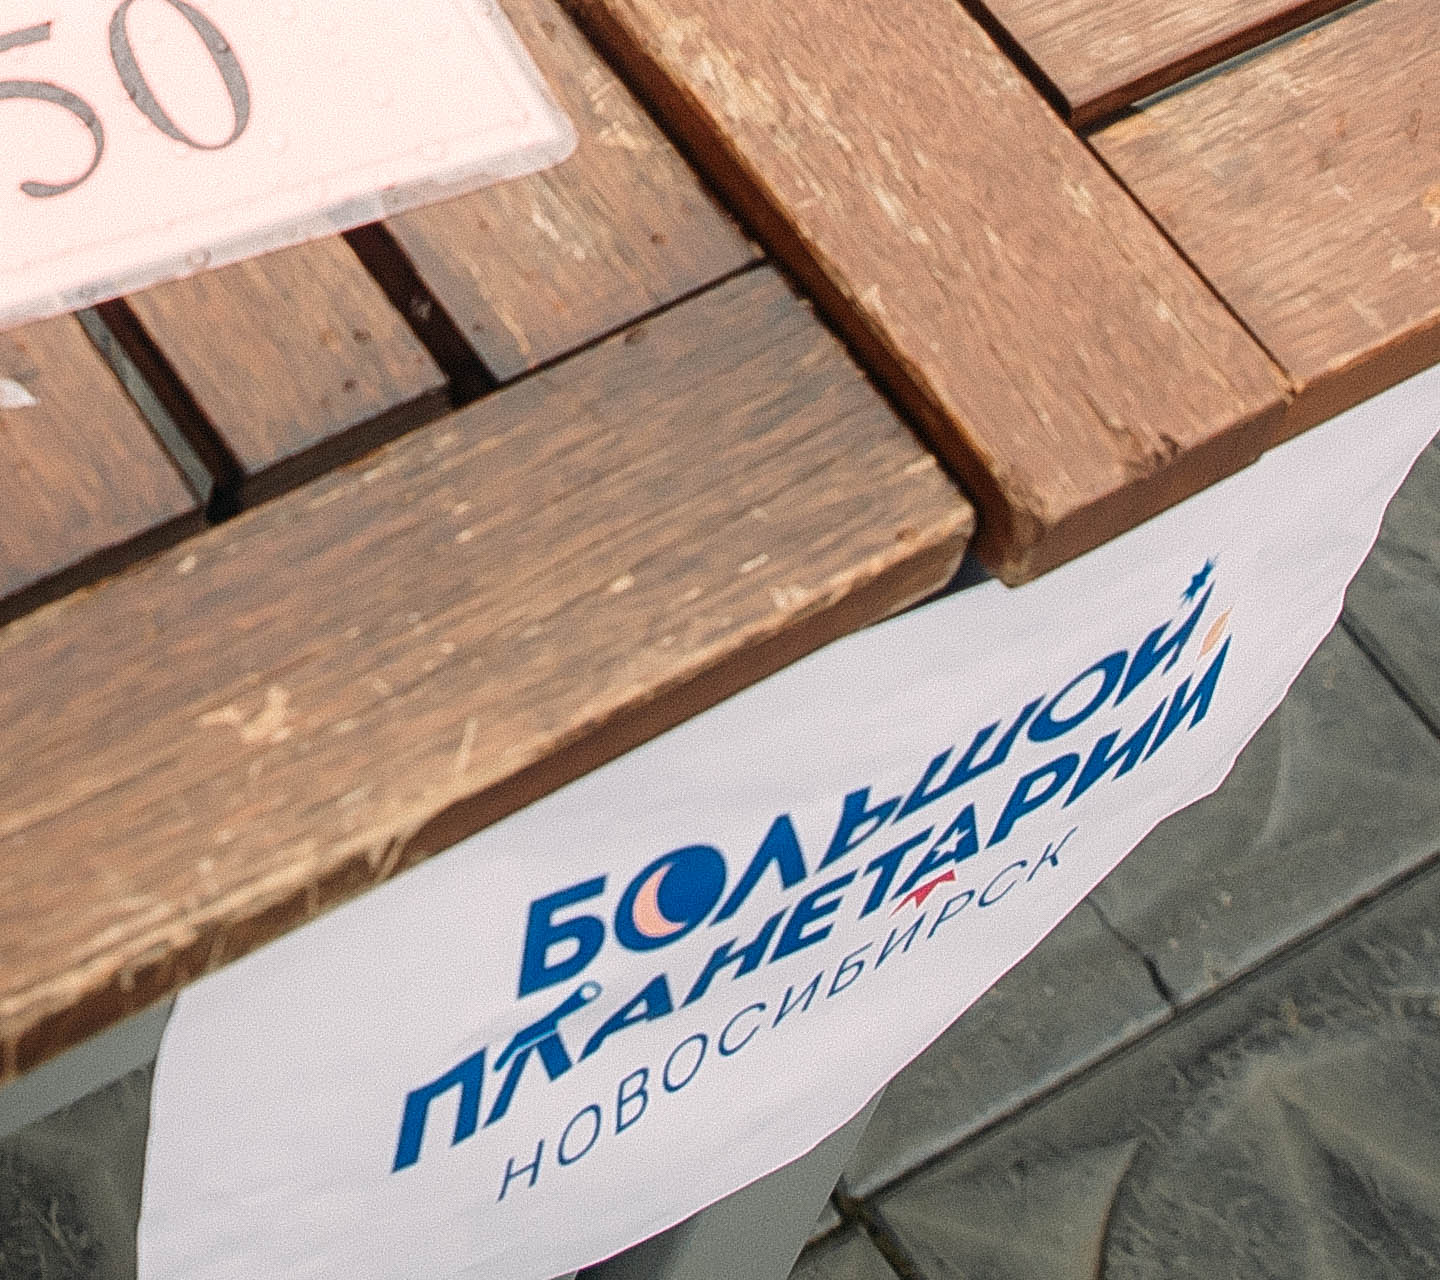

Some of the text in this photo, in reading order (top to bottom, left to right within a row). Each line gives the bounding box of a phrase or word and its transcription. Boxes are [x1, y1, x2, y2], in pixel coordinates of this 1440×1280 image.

[391, 608, 1234, 1174] ПЛАНЕТАРИЙ
[516, 555, 1218, 998] БОЛЬШОЙ
[497, 827, 1079, 1202] НОВОСИБИРСК
